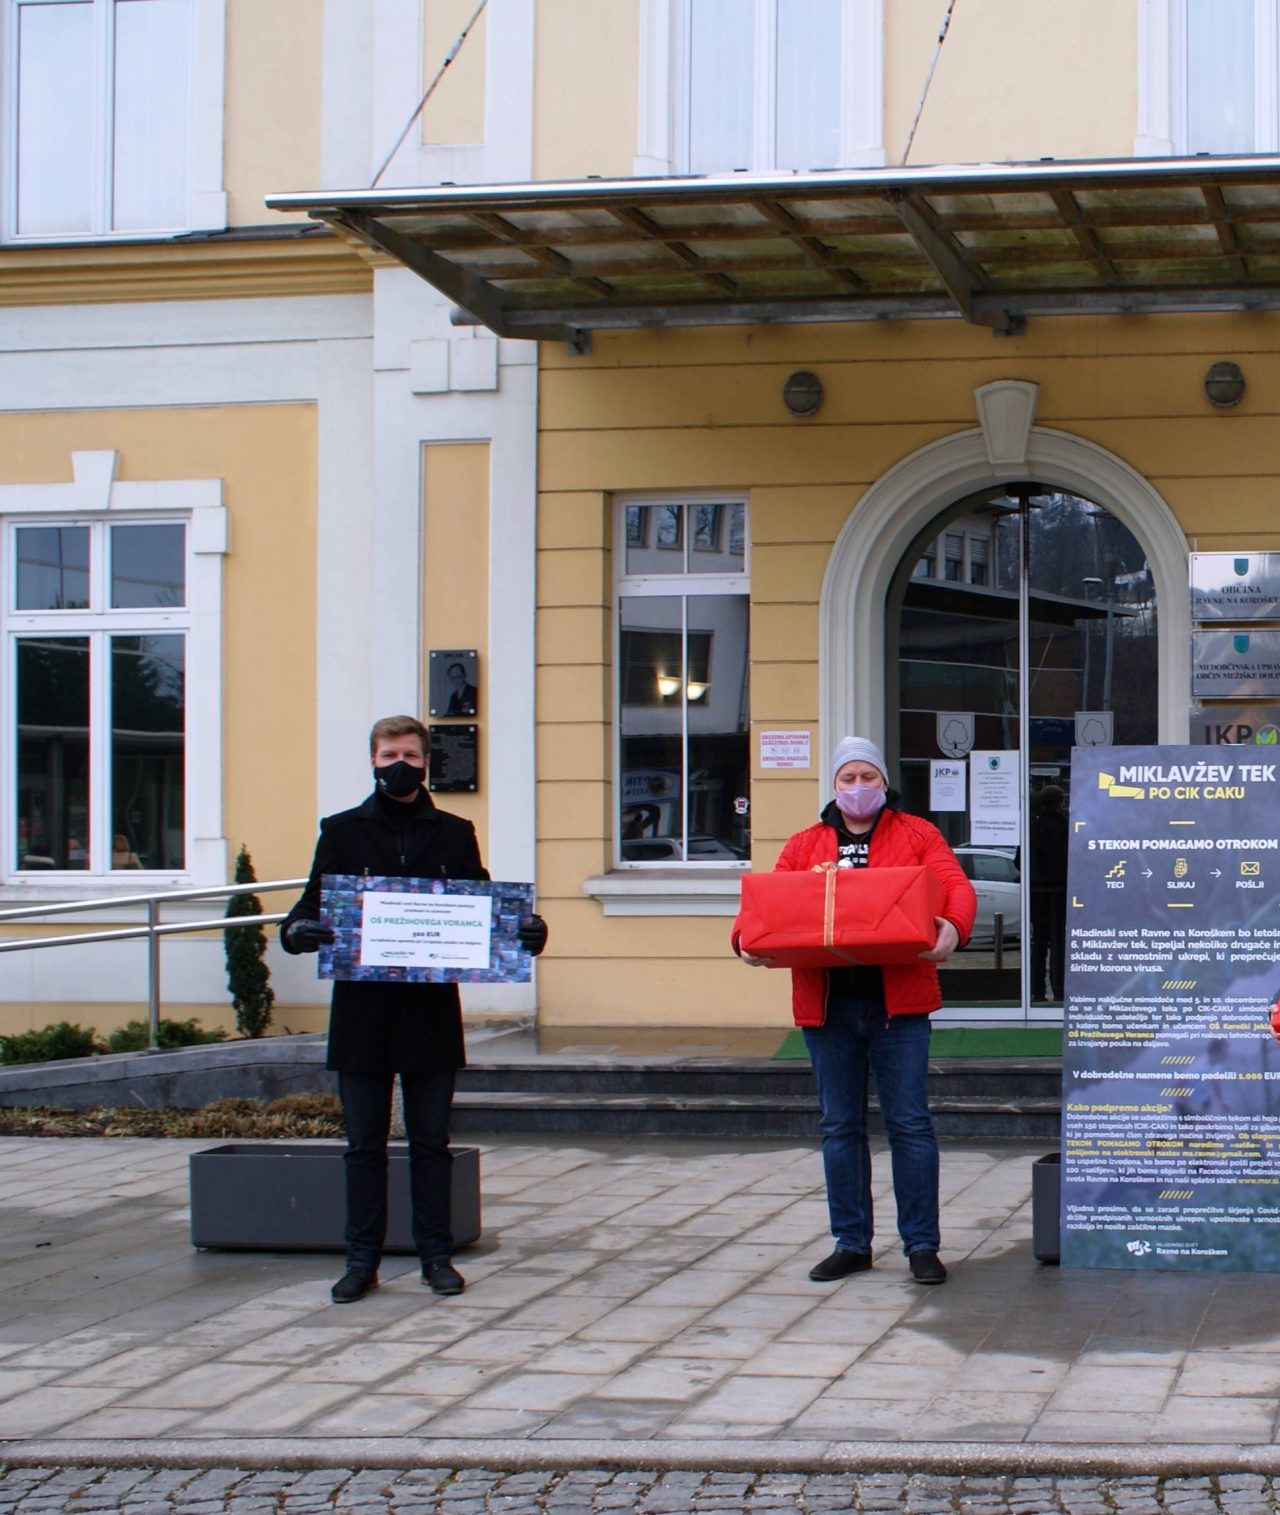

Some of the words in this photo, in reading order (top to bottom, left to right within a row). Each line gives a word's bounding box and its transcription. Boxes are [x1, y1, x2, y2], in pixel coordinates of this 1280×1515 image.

[1221, 583, 1261, 594] OBČINA
[1199, 662, 1255, 670] MEDOBČINSKA
[1222, 671, 1256, 679] MEŽIŠKE
[1119, 761, 1234, 783] MIKLAVŽEV
[1238, 765, 1276, 782] TEK
[1149, 787, 1171, 799] PO
[1174, 787, 1200, 799] CIK
[1203, 787, 1245, 799] CAKU
[1088, 840, 1097, 850] S
[1098, 840, 1140, 850] TEKOM
[1142, 840, 1214, 850] POMAGAMO
[1216, 839, 1278, 850] OTROKOM
[1106, 881, 1125, 889] TECI
[1167, 881, 1195, 889] SLIKAJ
[1235, 880, 1264, 889] POŠLJI
[370, 916, 382, 924] OŠ
[384, 917, 442, 926] PREŽIHOVEGA
[443, 919, 483, 927] VORANCA
[1071, 929, 1116, 937] Mladinski
[1118, 929, 1138, 937] svet
[1141, 929, 1171, 937] Ravne
[1188, 928, 1235, 937] Koroškem
[1238, 929, 1251, 937] bo
[1071, 941, 1080, 949] 6.
[1082, 940, 1128, 949] Miklavžev
[1131, 941, 1148, 950] tek,
[1151, 940, 1185, 951] izpeljal
[1188, 940, 1228, 949] nekoliko
[1230, 940, 1271, 951] drugače
[1070, 952, 1102, 960] skladu
[1118, 952, 1173, 960] varnostnimi
[1178, 952, 1210, 962] ukrepi,
[1216, 952, 1225, 960] ki
[1070, 964, 1099, 972] širitev
[1100, 964, 1132, 972] korona
[1134, 964, 1165, 972] virusa.
[1080, 1071, 1134, 1079] dobrodelne
[1201, 1072, 1236, 1081] podelili
[1091, 1104, 1139, 1112] podpremo
[1141, 1105, 1173, 1113] akcijo?
